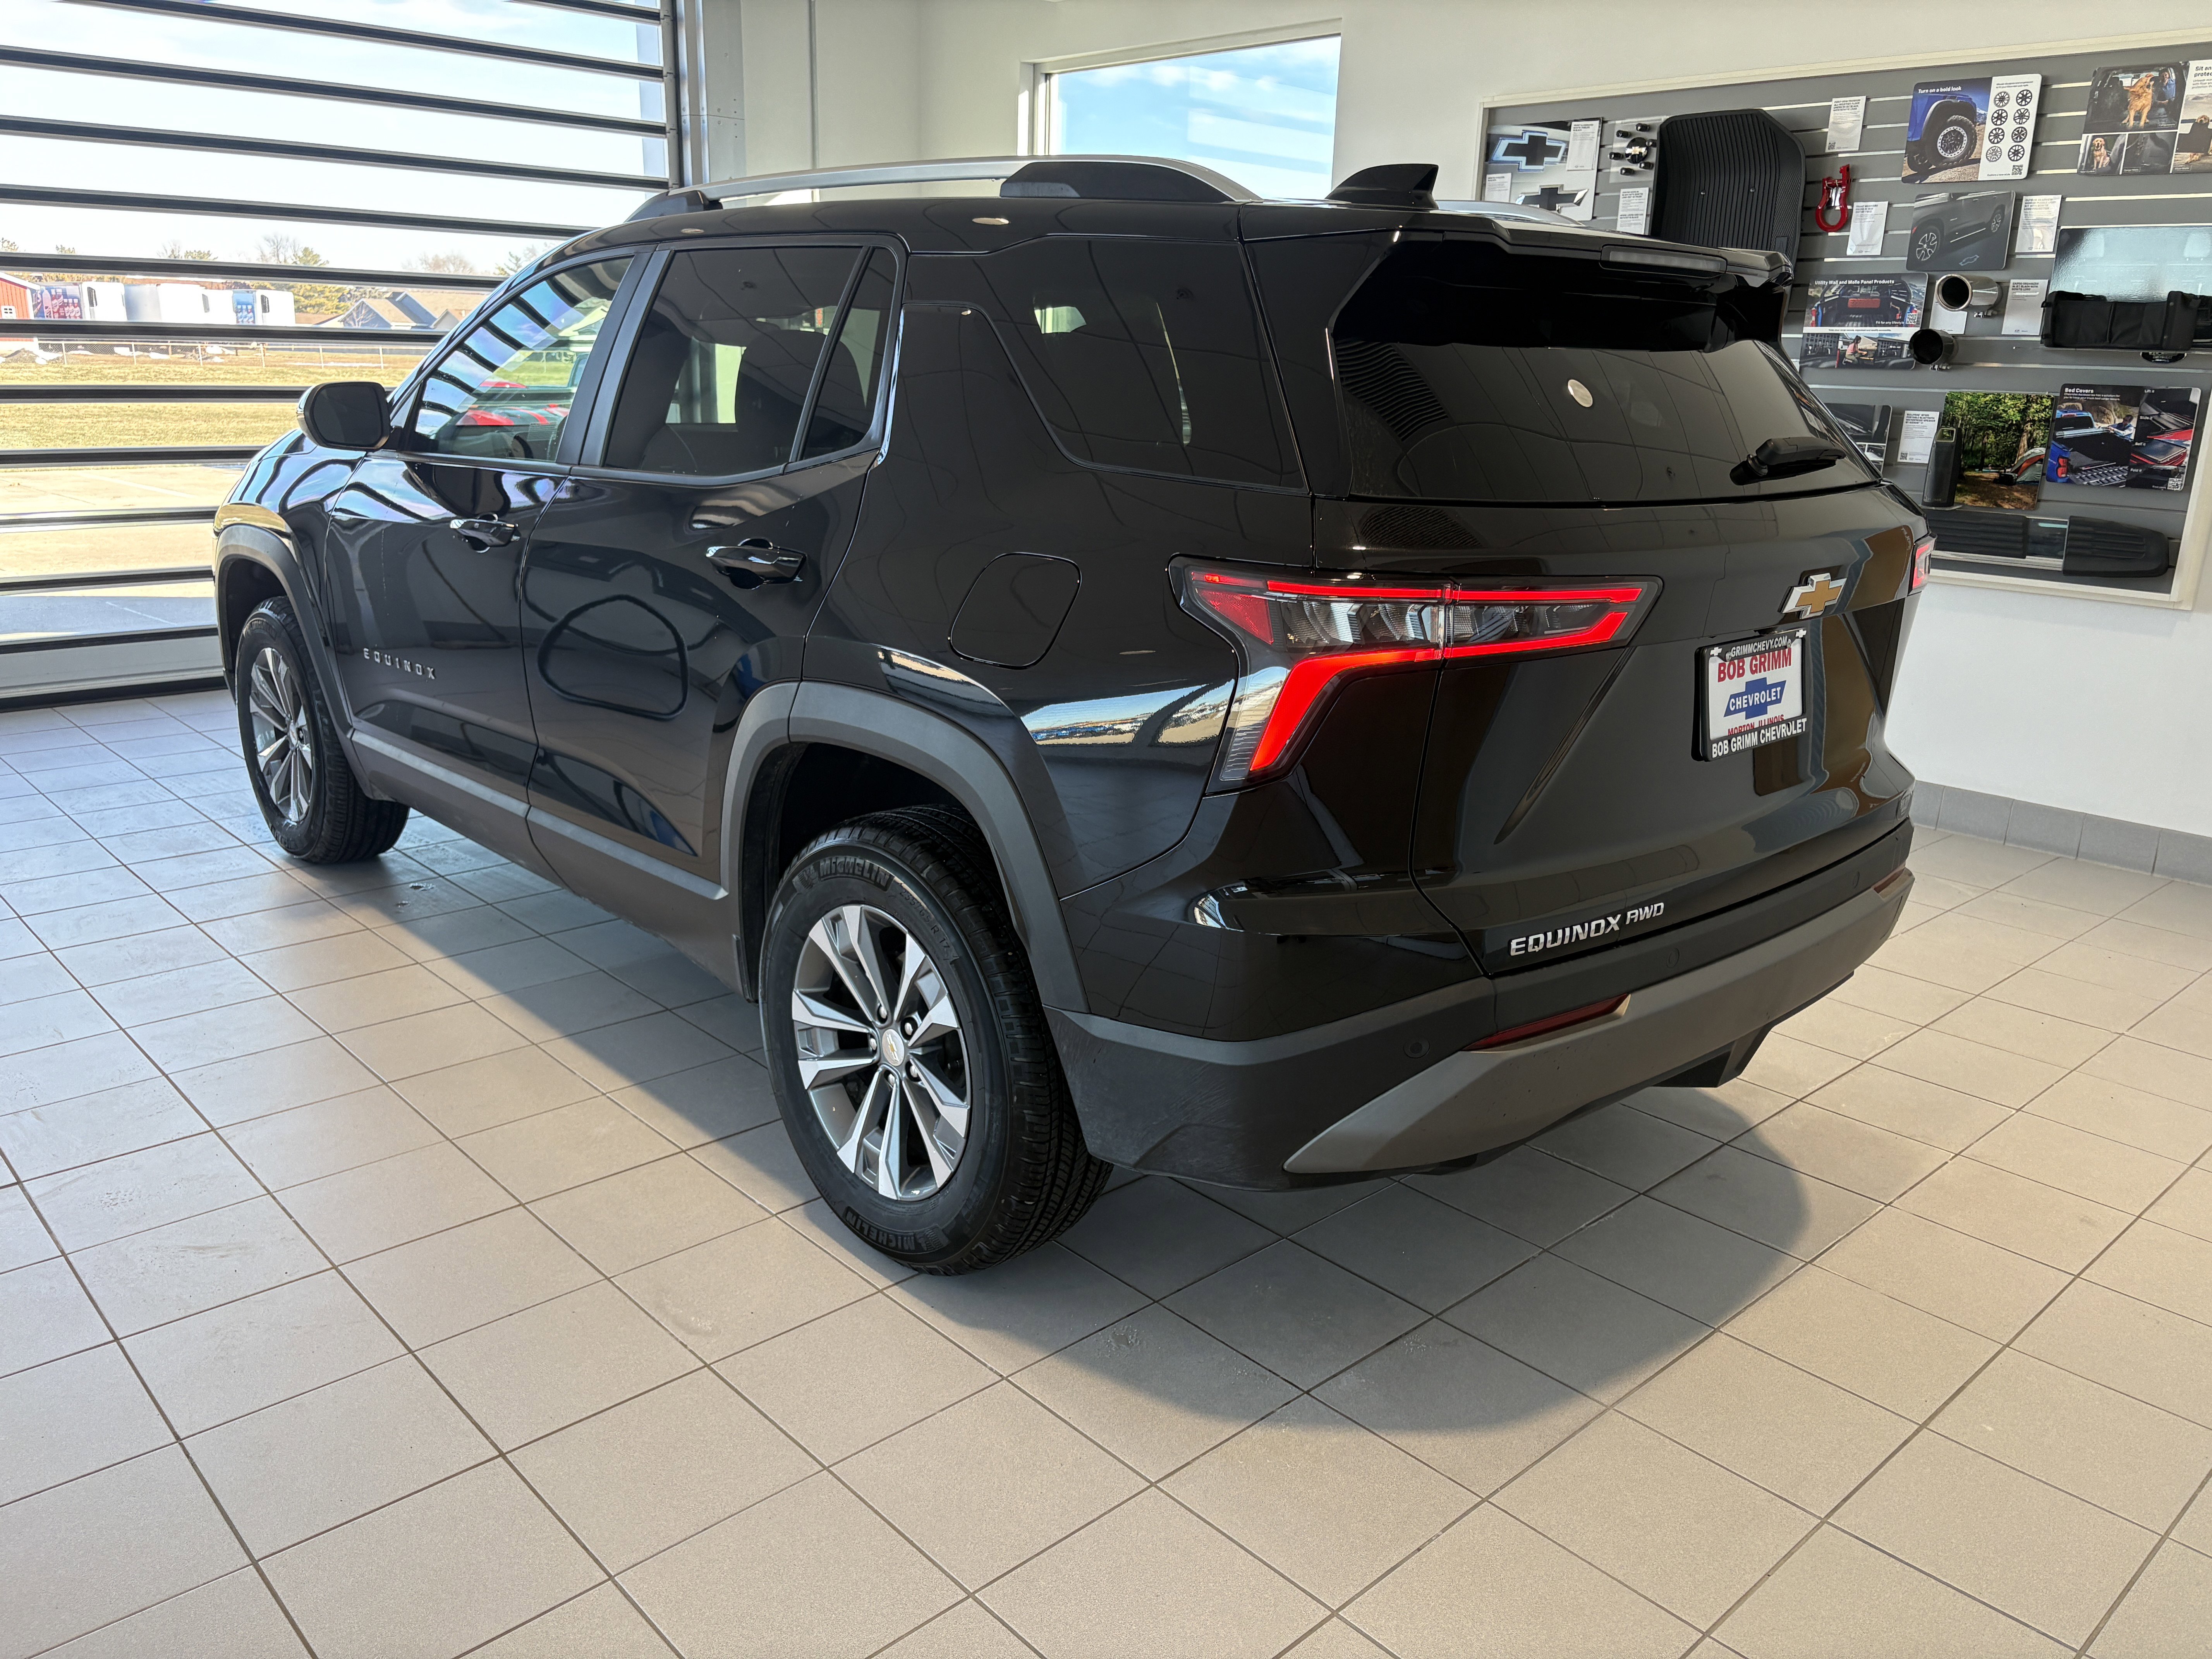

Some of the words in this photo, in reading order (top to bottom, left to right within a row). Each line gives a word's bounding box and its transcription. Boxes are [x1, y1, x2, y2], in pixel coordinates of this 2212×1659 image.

[363, 647, 435, 680] EQUINOX
[1731, 635, 1788, 658] GRIMMCHEVY.COM
[1717, 658, 1745, 683] BOB
[1749, 647, 1791, 675] GRIMM
[1729, 687, 1781, 711] CHEVROLET
[1712, 739, 1729, 758] BOB
[1730, 731, 1758, 753] GRIMM
[1760, 718, 1807, 744] CHEVROLET
[819, 856, 890, 888] MICHELIN
[1510, 914, 1621, 957] EQUINOX
[1625, 902, 1664, 925] AWD
[845, 1210, 917, 1251] MICHELIN
